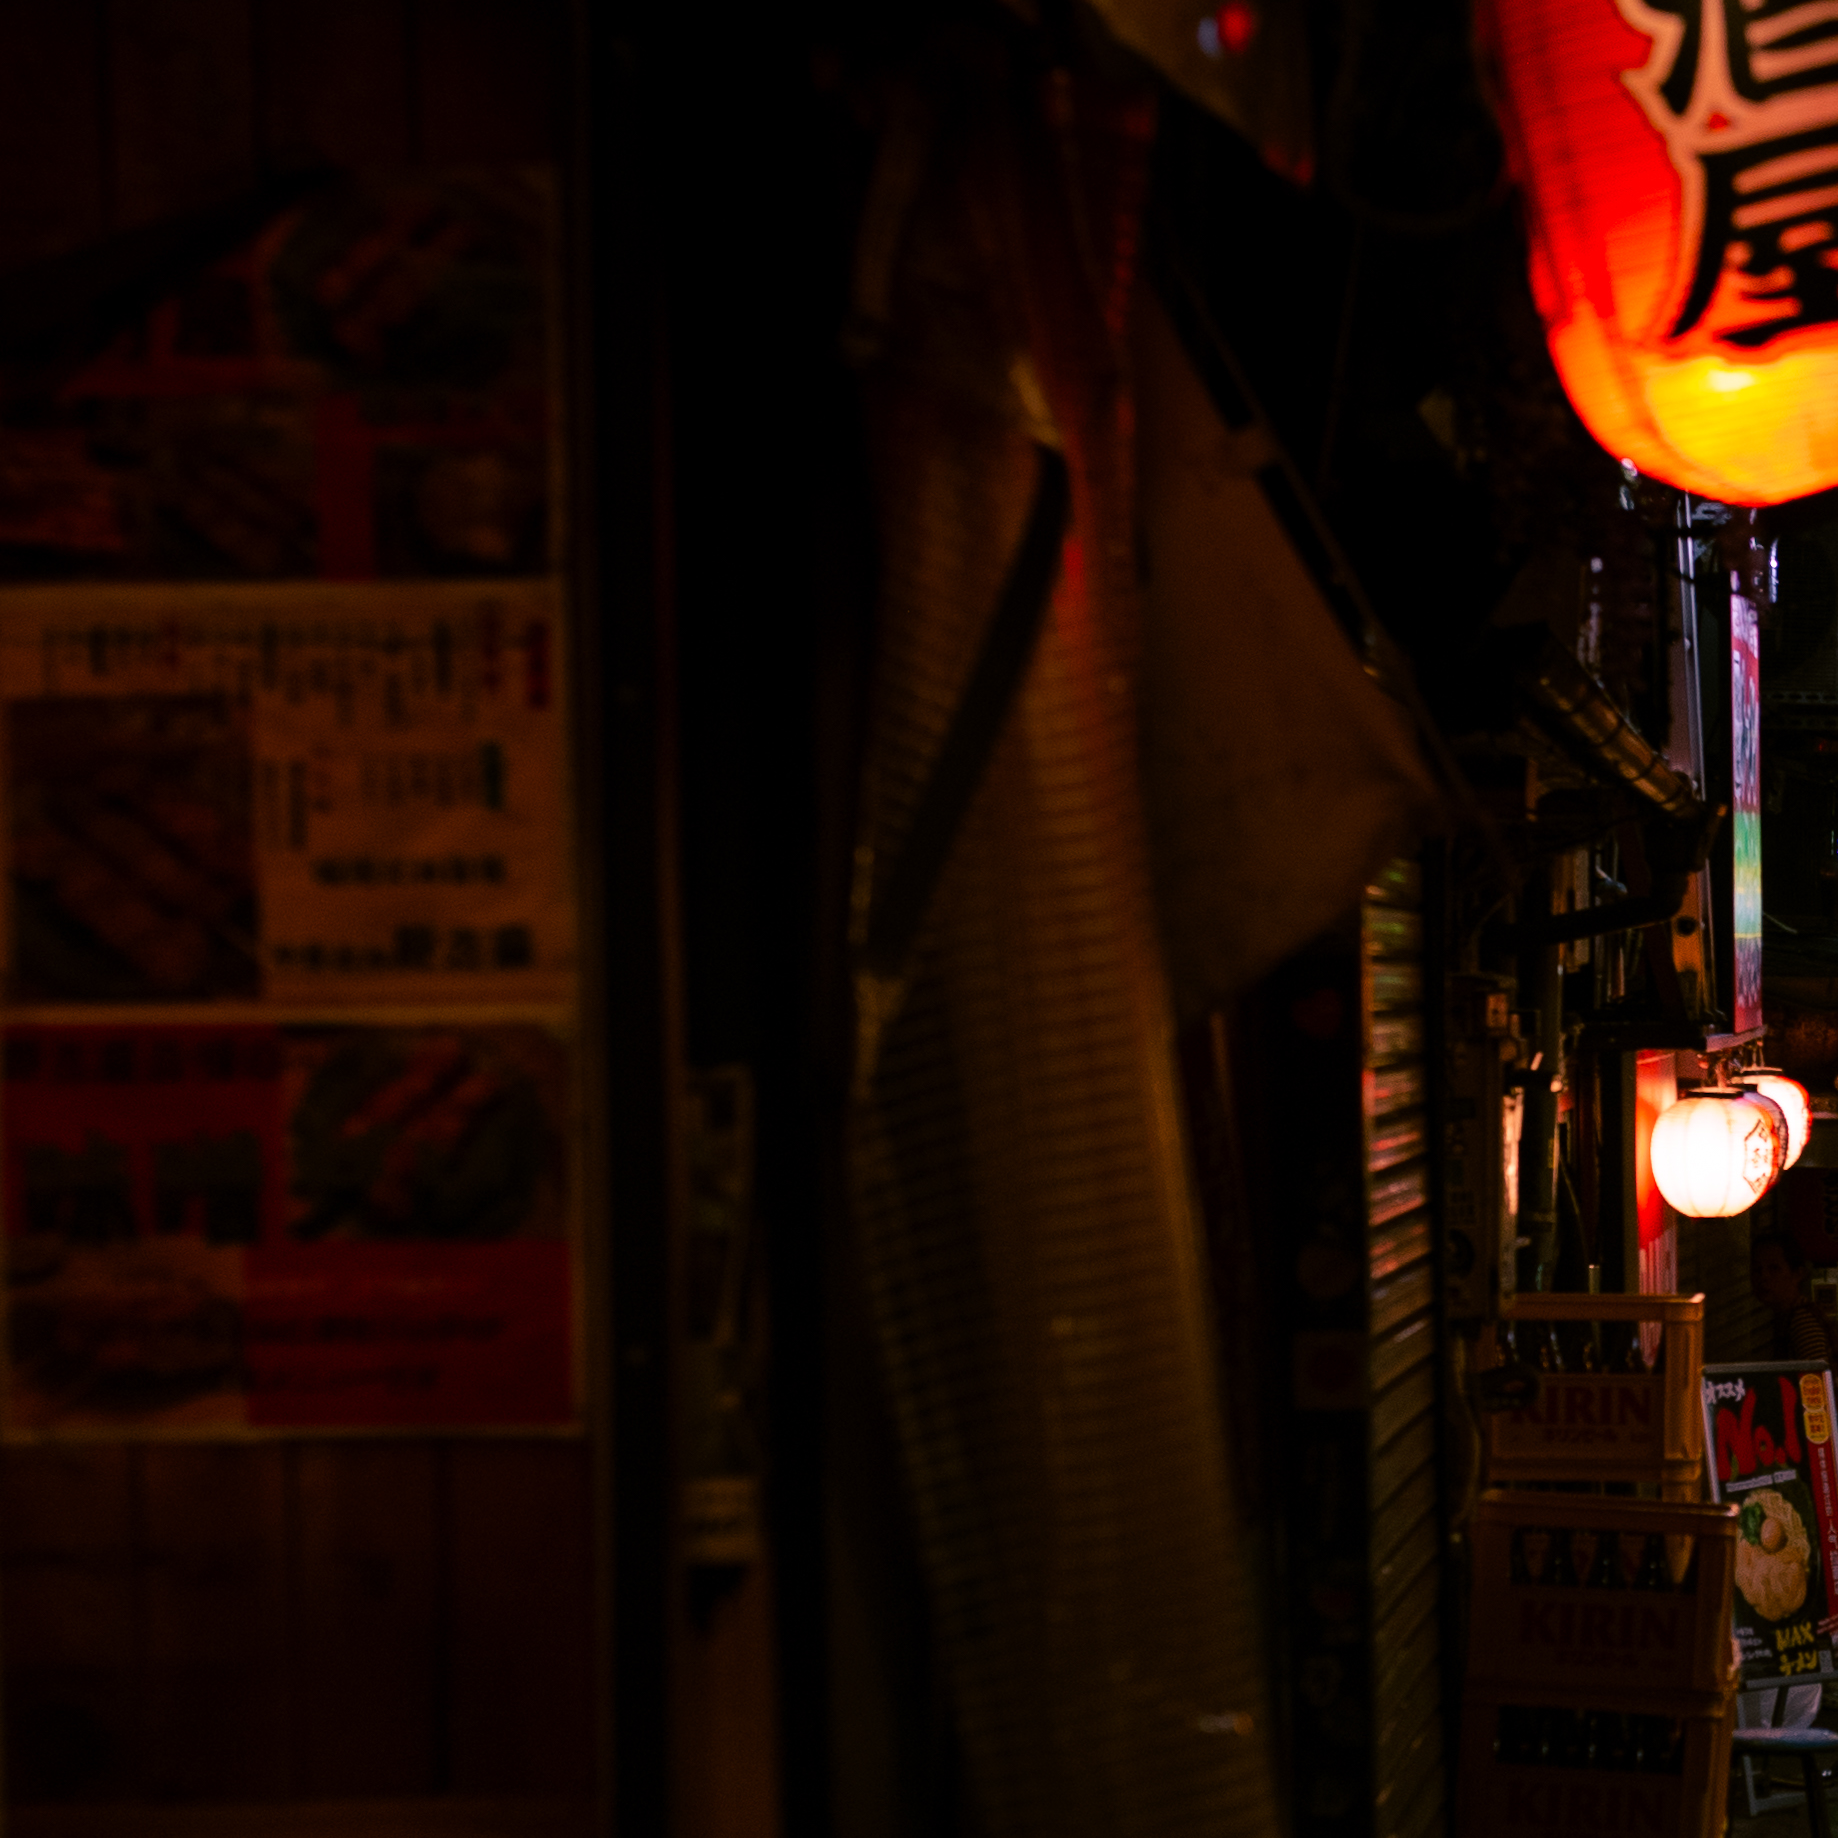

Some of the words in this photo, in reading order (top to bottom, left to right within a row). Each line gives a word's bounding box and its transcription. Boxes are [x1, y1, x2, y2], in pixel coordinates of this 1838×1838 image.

[1717, 1375, 1803, 1482] No.1
[1519, 1599, 1678, 1650] KIRIN
[1506, 1780, 1664, 1832] KIRIN
